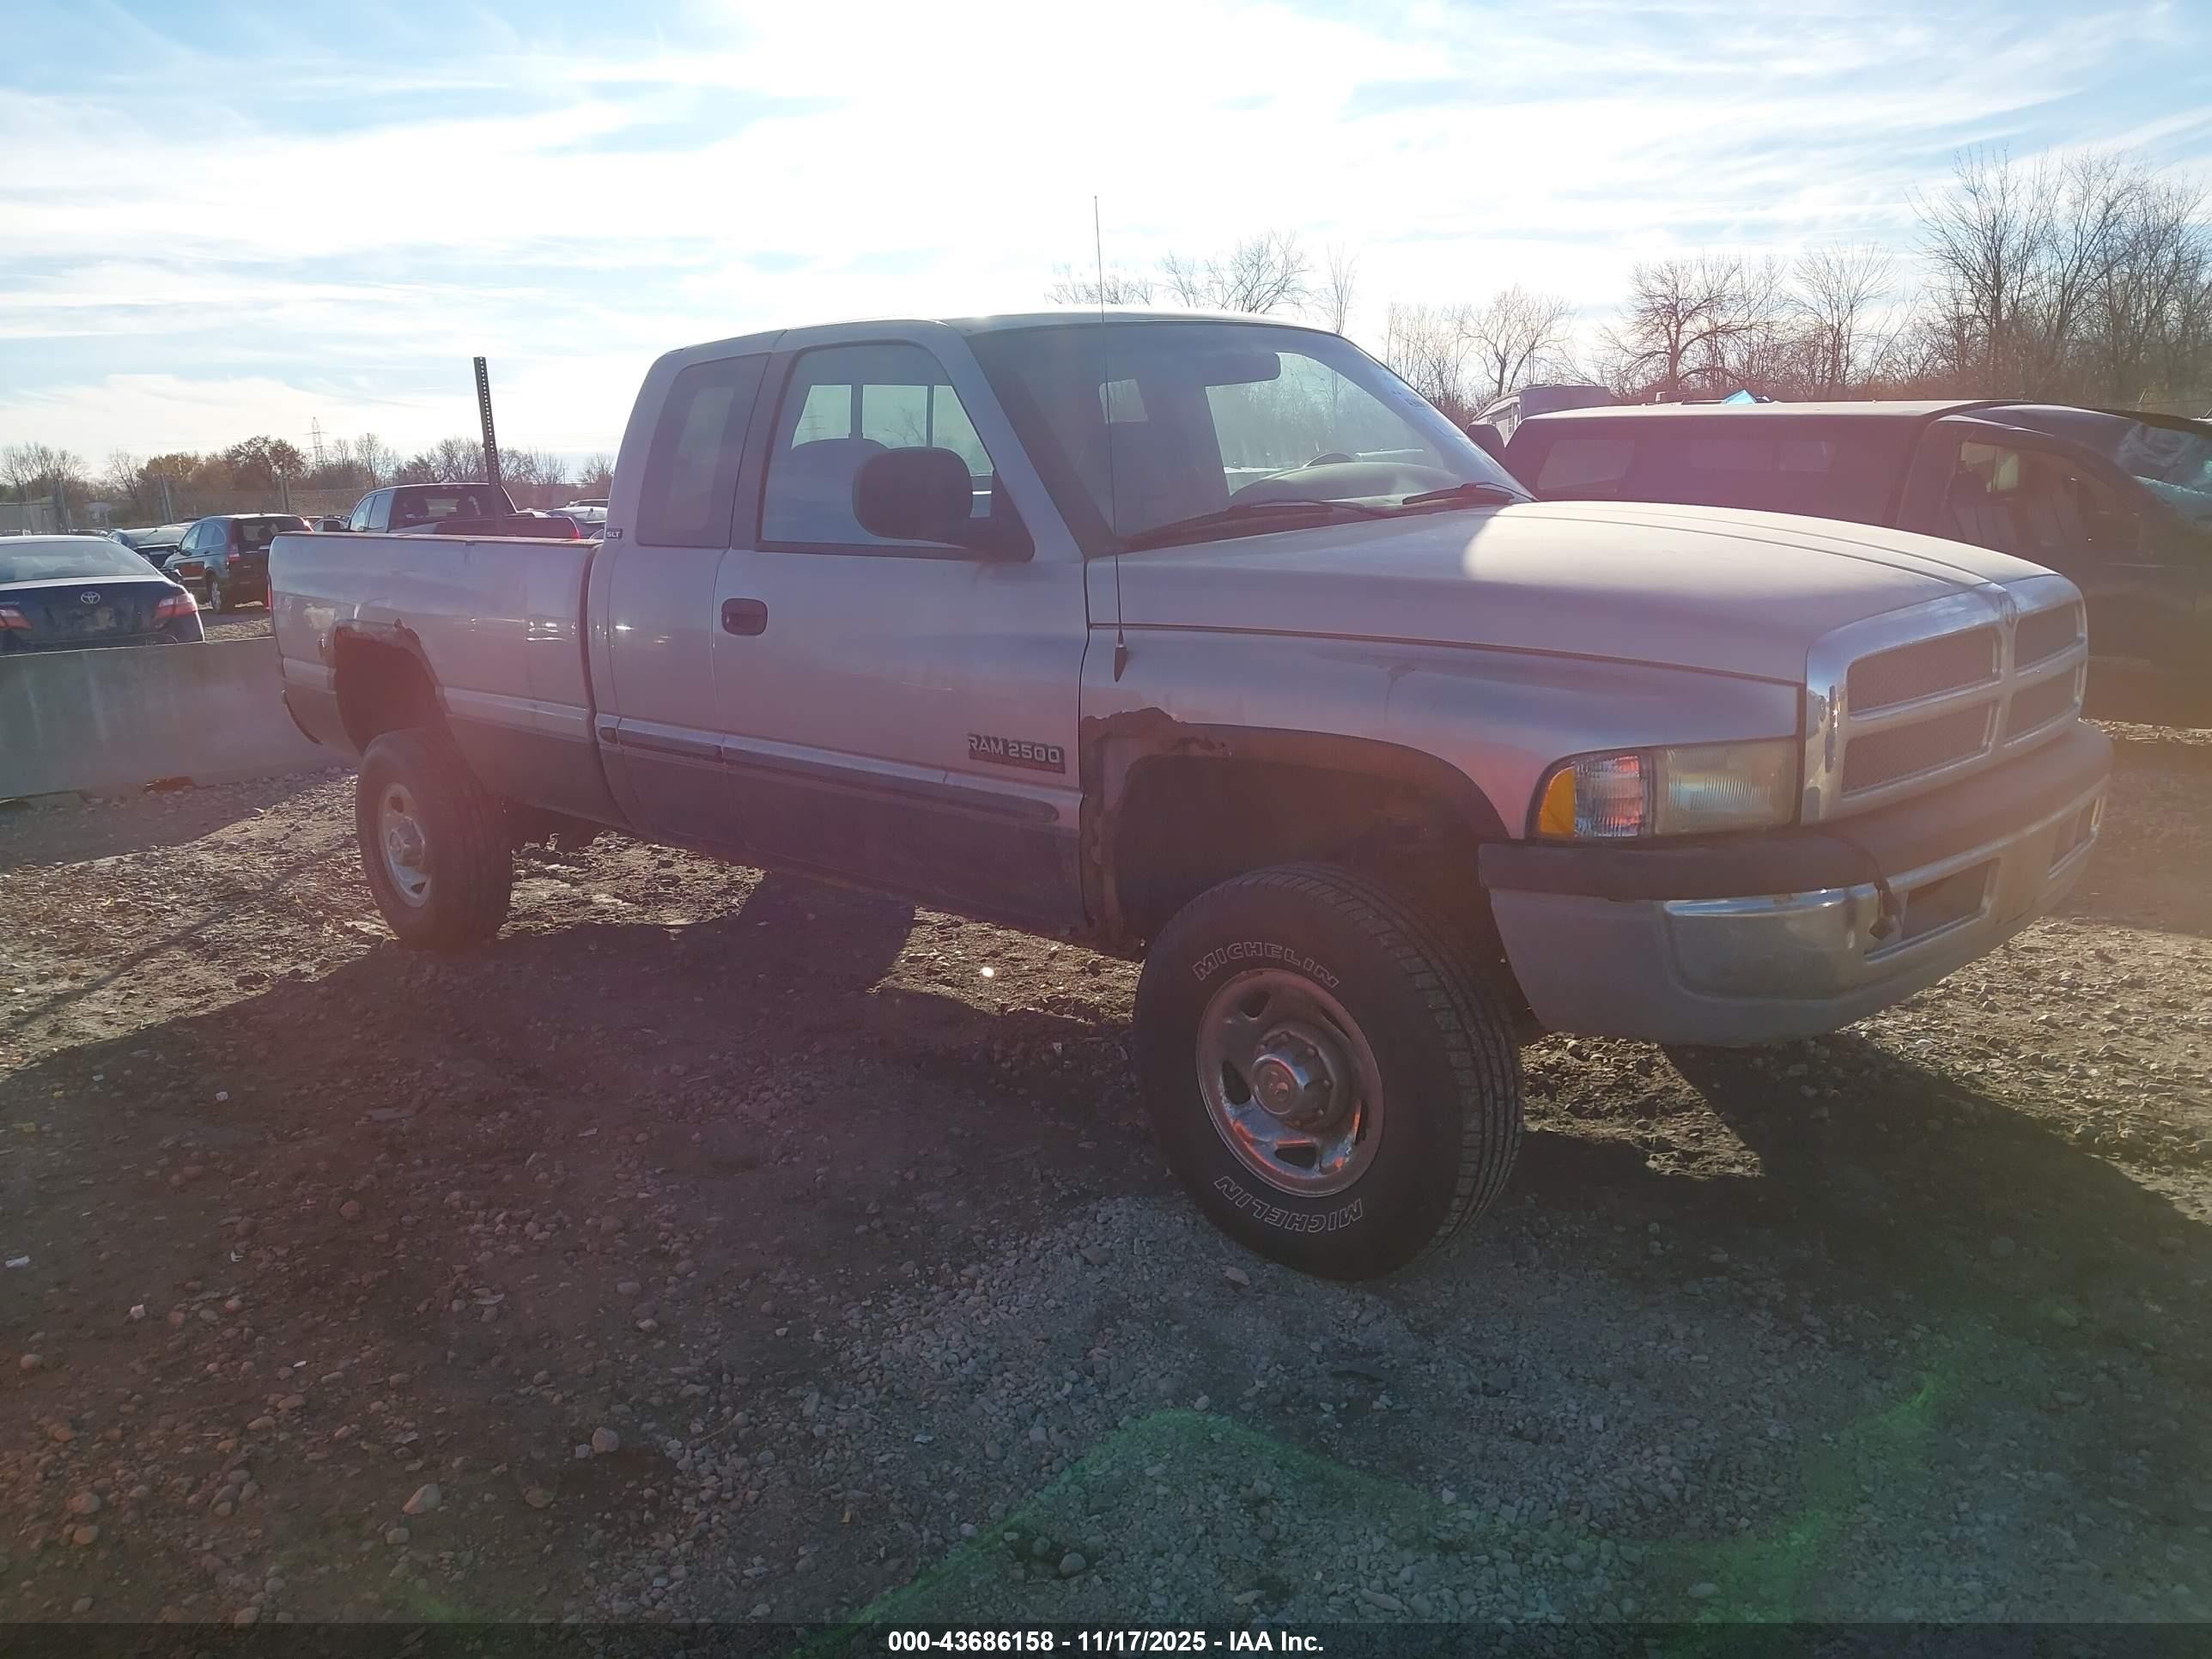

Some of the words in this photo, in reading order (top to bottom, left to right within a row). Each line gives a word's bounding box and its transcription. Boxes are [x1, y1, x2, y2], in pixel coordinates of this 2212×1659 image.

[968, 736, 1004, 756] RAM
[1008, 742, 1060, 763] 2500
[1191, 941, 1340, 988] MICHELIN
[1213, 1175, 1364, 1233] MICHELIN
